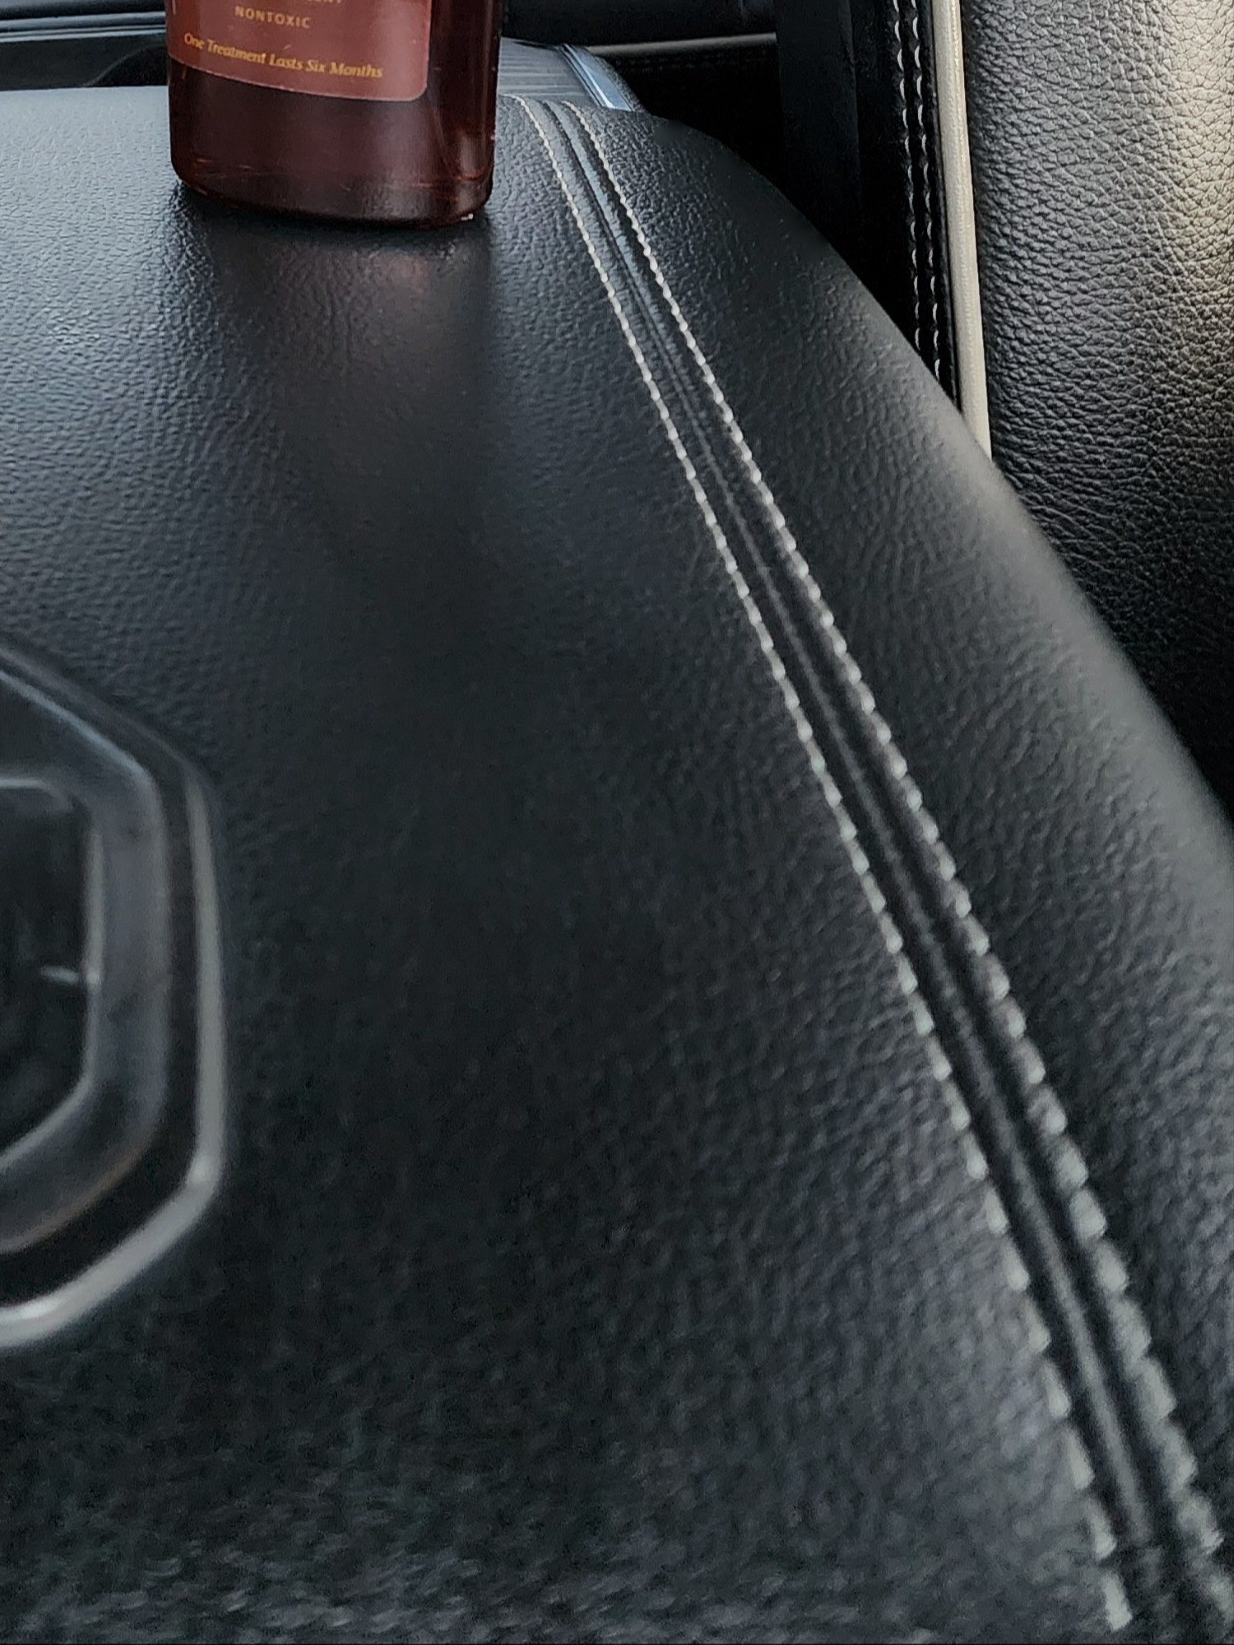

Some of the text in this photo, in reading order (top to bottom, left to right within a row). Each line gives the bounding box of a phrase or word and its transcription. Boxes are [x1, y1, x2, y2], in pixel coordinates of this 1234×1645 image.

[235, 5, 311, 29] NONTOXIC
[184, 32, 383, 78] One Treatment Lasts Six Months
